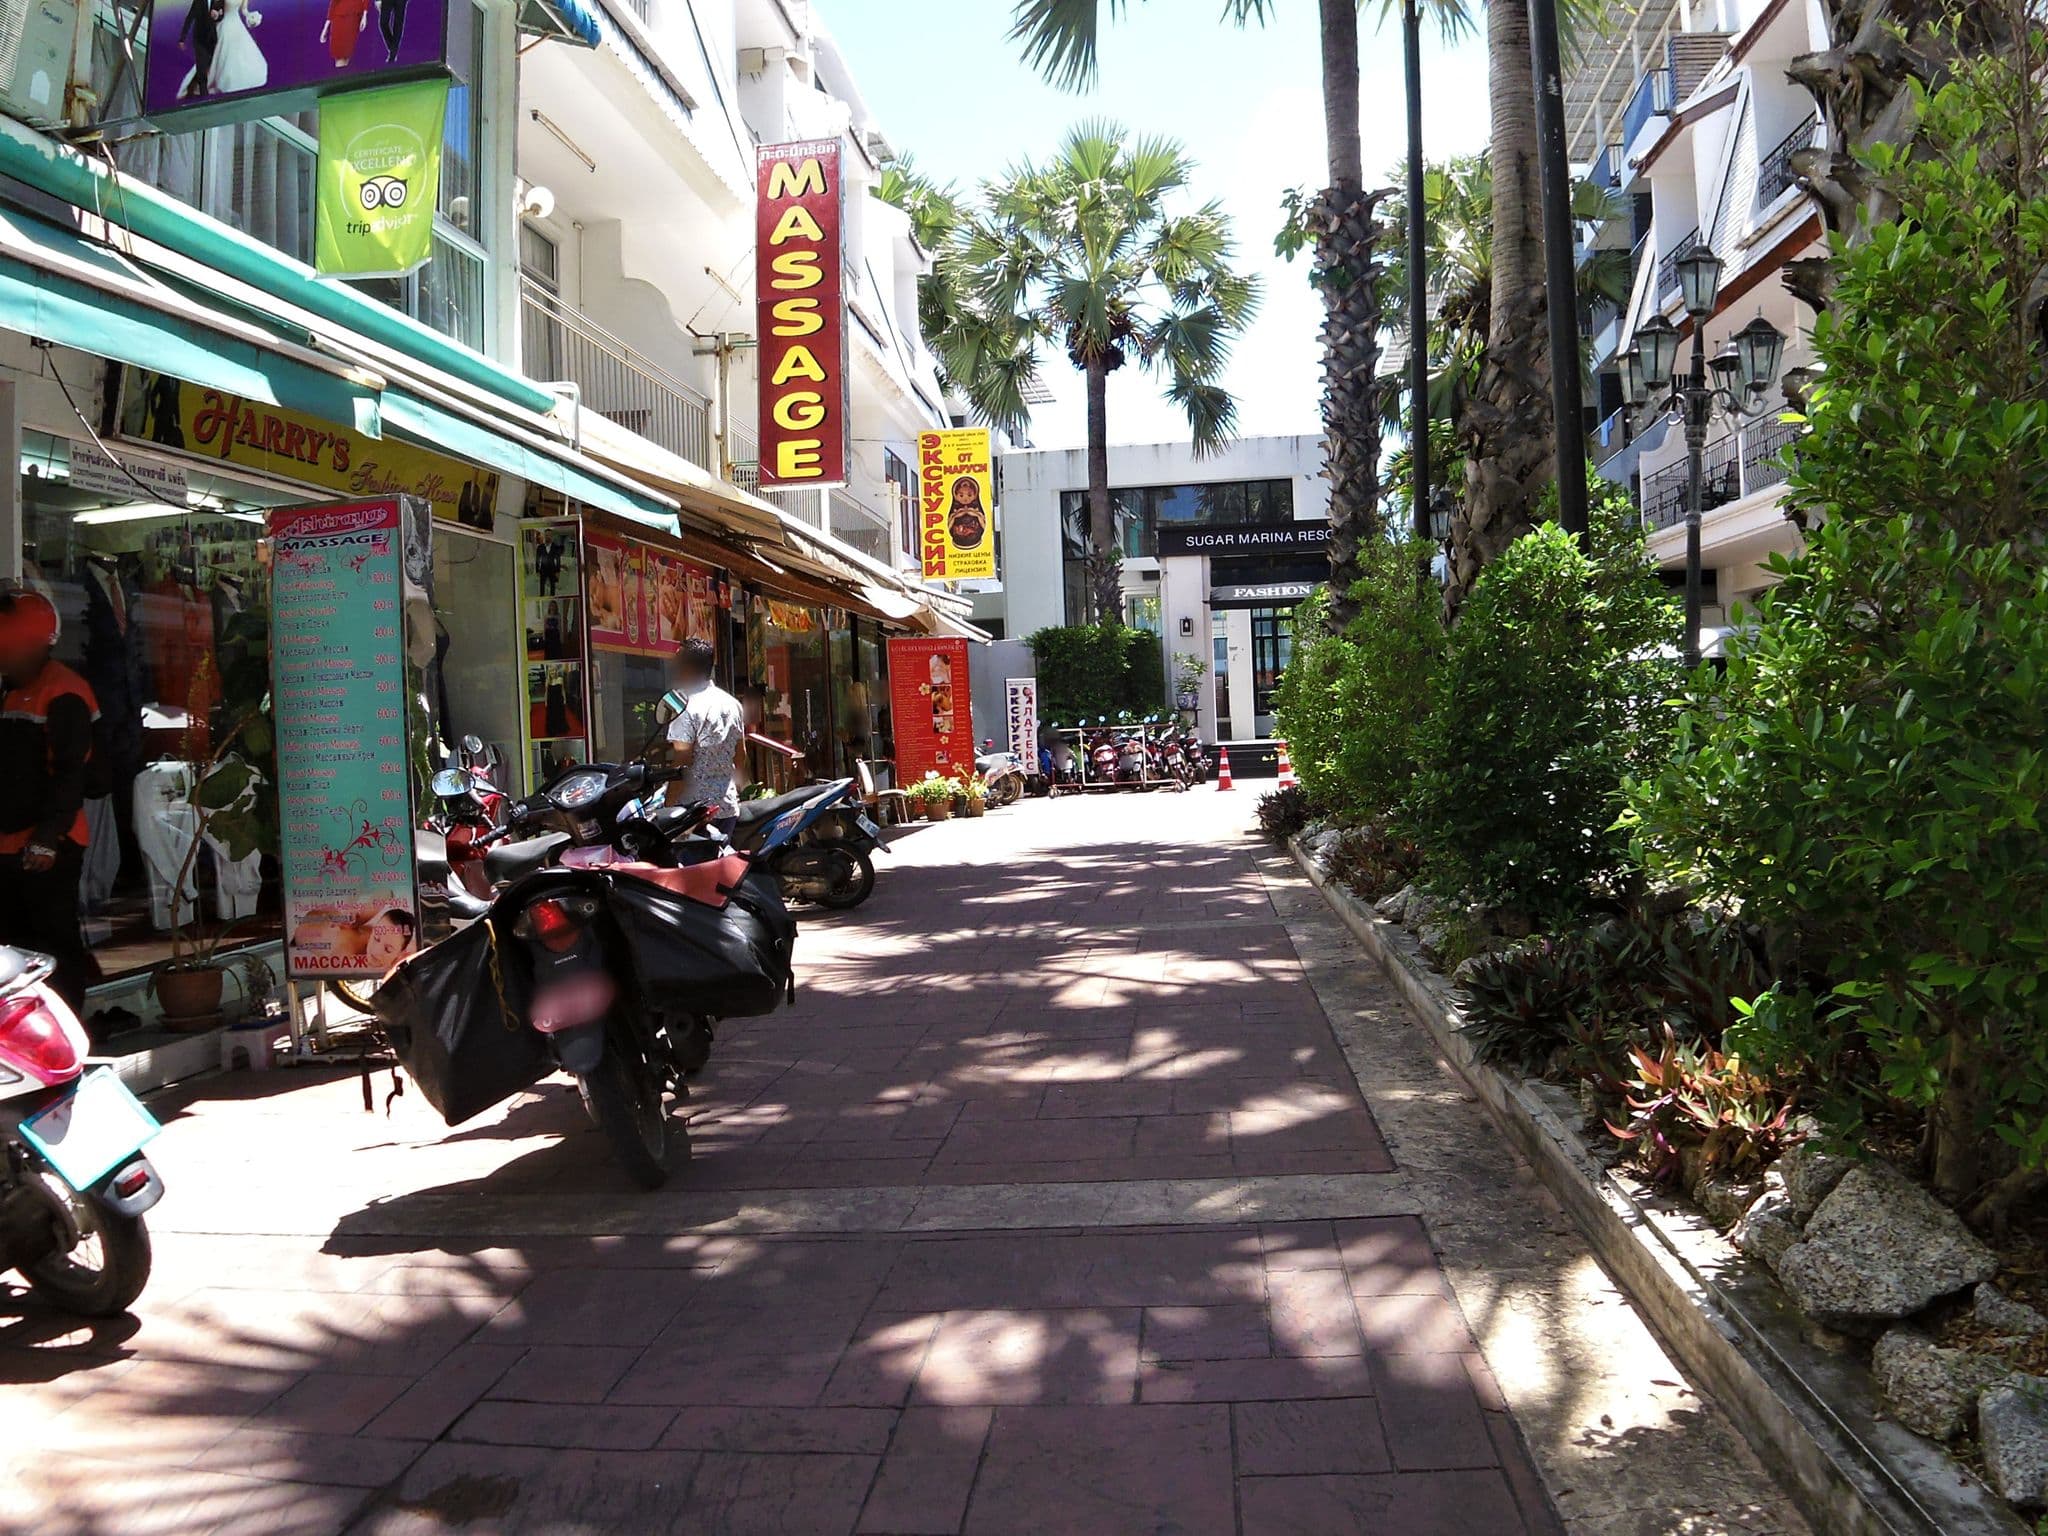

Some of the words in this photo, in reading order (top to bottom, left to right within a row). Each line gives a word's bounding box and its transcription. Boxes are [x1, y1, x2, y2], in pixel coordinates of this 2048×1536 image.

[766, 158, 828, 481] MASSAGE
[193, 388, 350, 472] HARRY'S
[958, 453, 973, 463] ОТ
[943, 463, 988, 475] МАРУСИ
[921, 433, 947, 577] ЭКСКУРСИИ
[280, 533, 385, 551] MASSAGE
[1186, 534, 1235, 547] SUGAR
[1238, 531, 1294, 544] MARINA
[1233, 585, 1312, 598] FASHION
[293, 955, 369, 970] МАССАЖ
